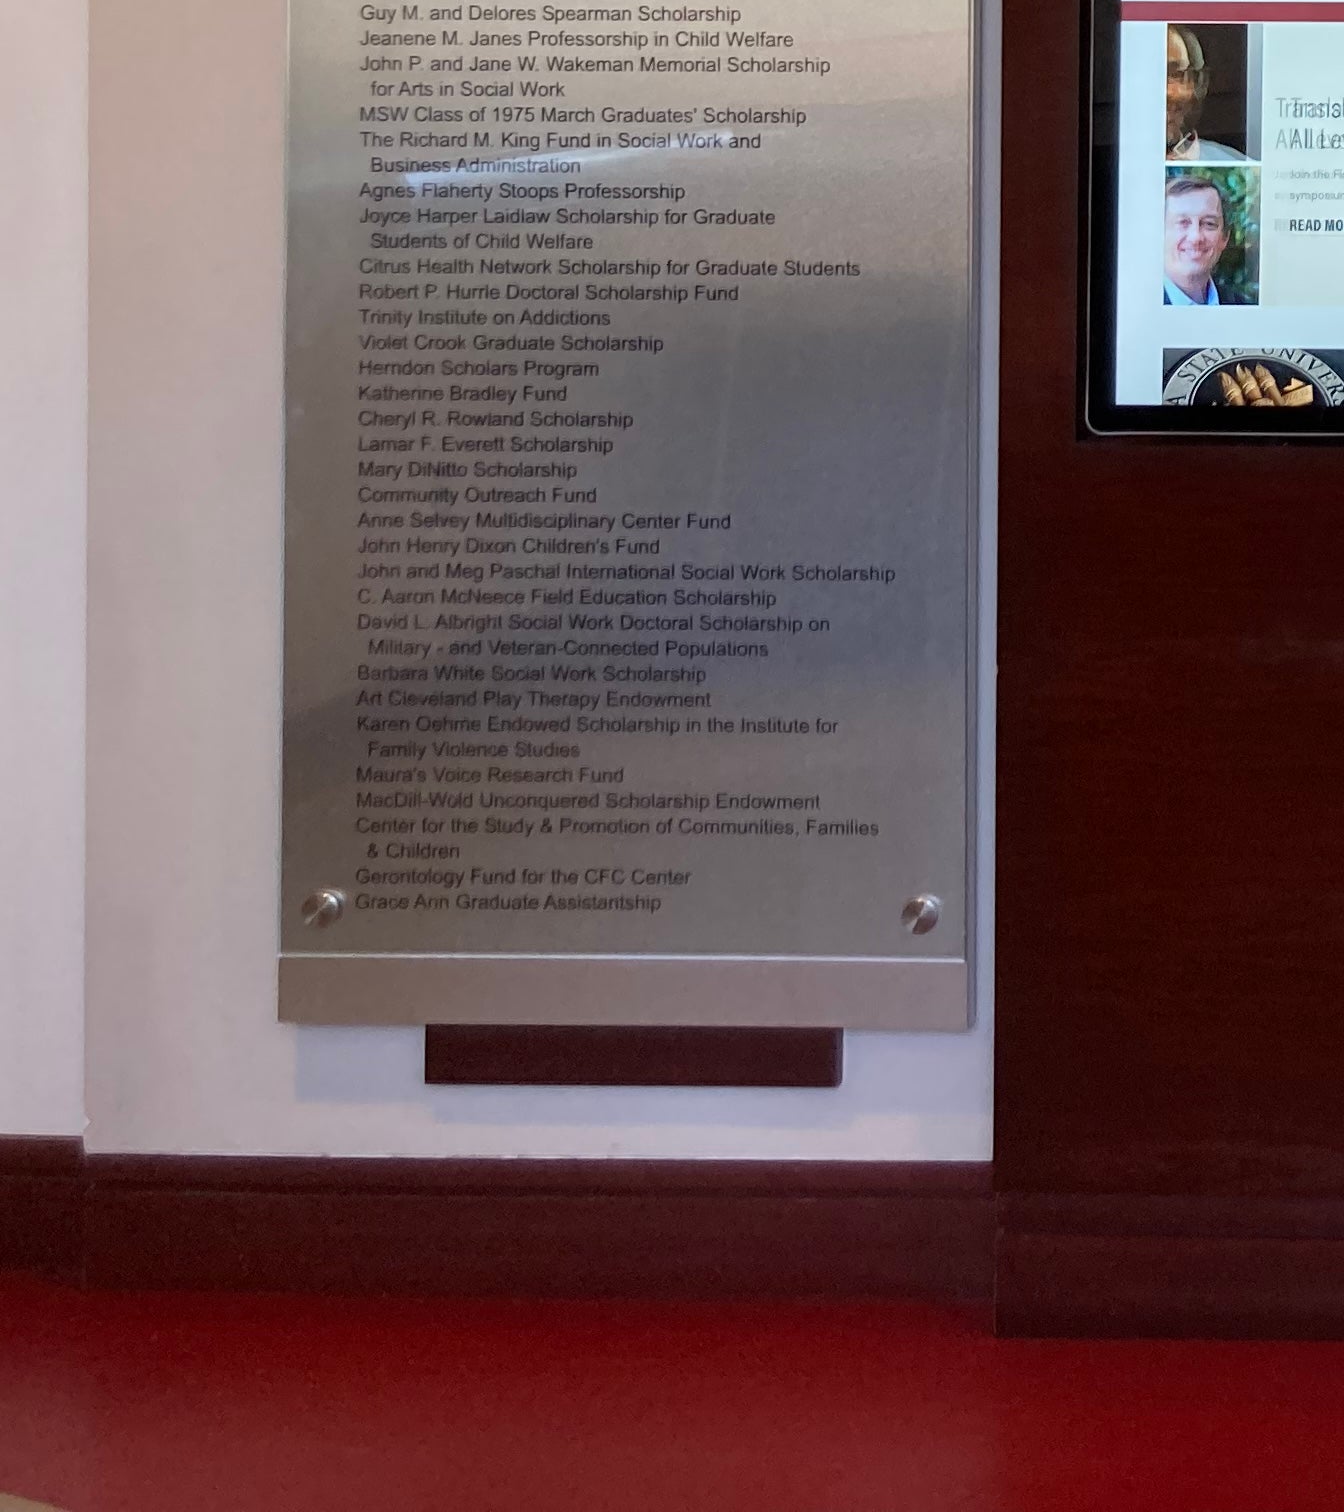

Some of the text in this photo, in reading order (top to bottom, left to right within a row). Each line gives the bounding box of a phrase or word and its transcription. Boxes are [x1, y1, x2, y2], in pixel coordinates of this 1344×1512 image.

[360, 106, 807, 129] MSW Class of 1975 March Graduates' Scholarship
[1289, 219, 1321, 232] READ
[355, 766, 624, 784] Maura's Voice Research Fund
